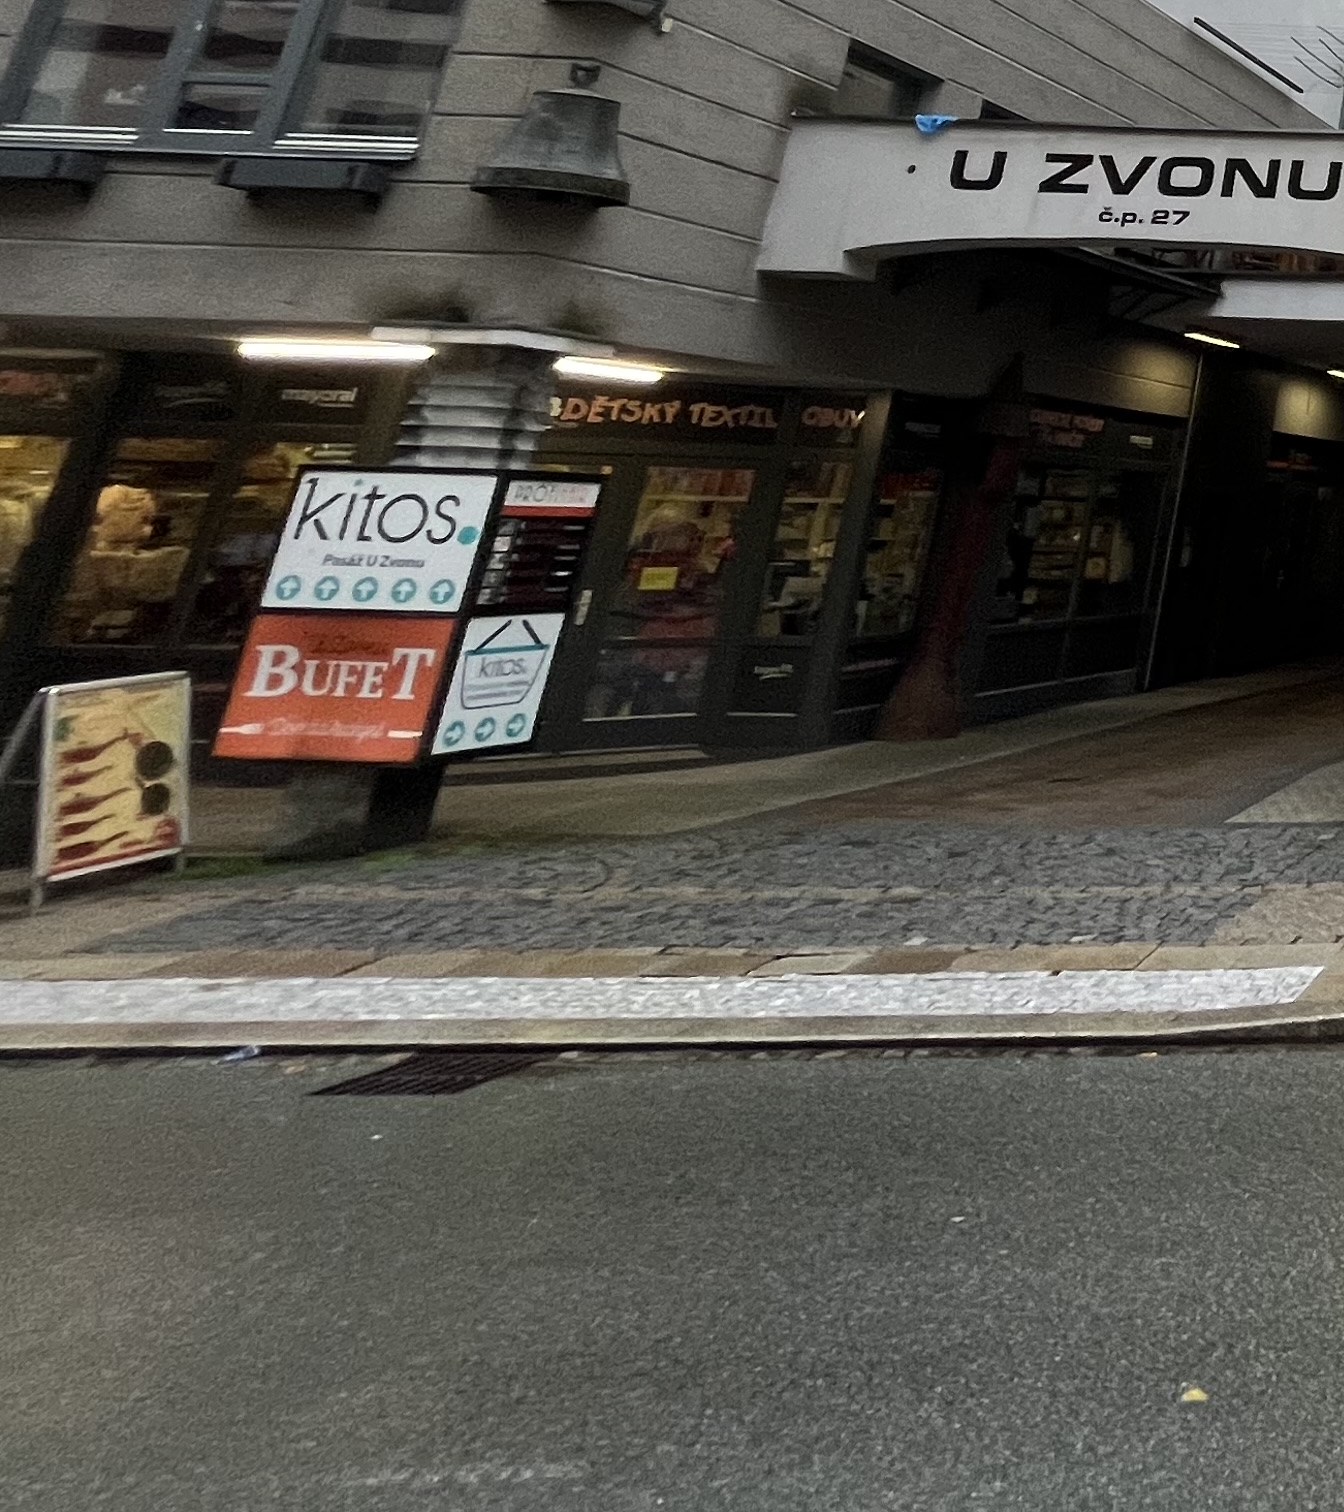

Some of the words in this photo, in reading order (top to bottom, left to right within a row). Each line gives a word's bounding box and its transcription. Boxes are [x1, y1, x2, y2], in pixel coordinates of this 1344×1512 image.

[949, 150, 1008, 191] U
[1038, 152, 1344, 201] ZVONU
[1098, 206, 1144, 228] č.p.
[1151, 209, 1190, 226] 27
[560, 395, 682, 425] DĚTSKÝ
[689, 401, 778, 430] TEXTIL
